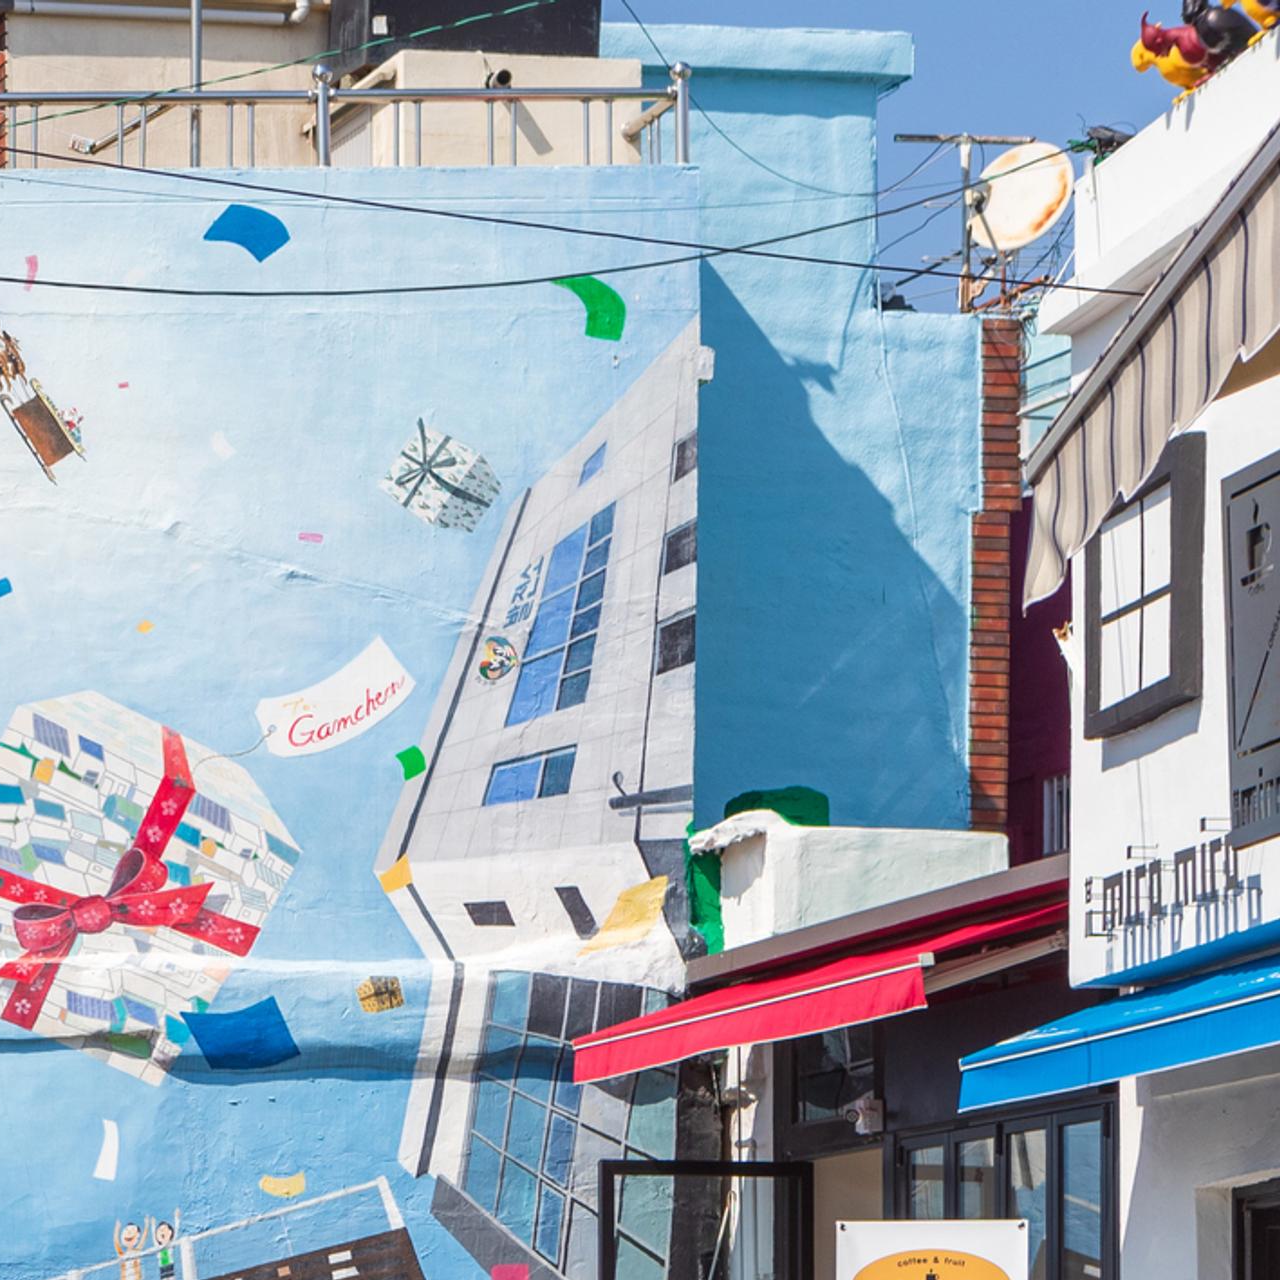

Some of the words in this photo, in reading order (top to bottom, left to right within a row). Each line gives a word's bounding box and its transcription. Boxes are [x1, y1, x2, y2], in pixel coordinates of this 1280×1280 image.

[897, 1256, 928, 1267] coffee
[933, 1256, 940, 1265] &
[944, 1257, 966, 1267] fruit
